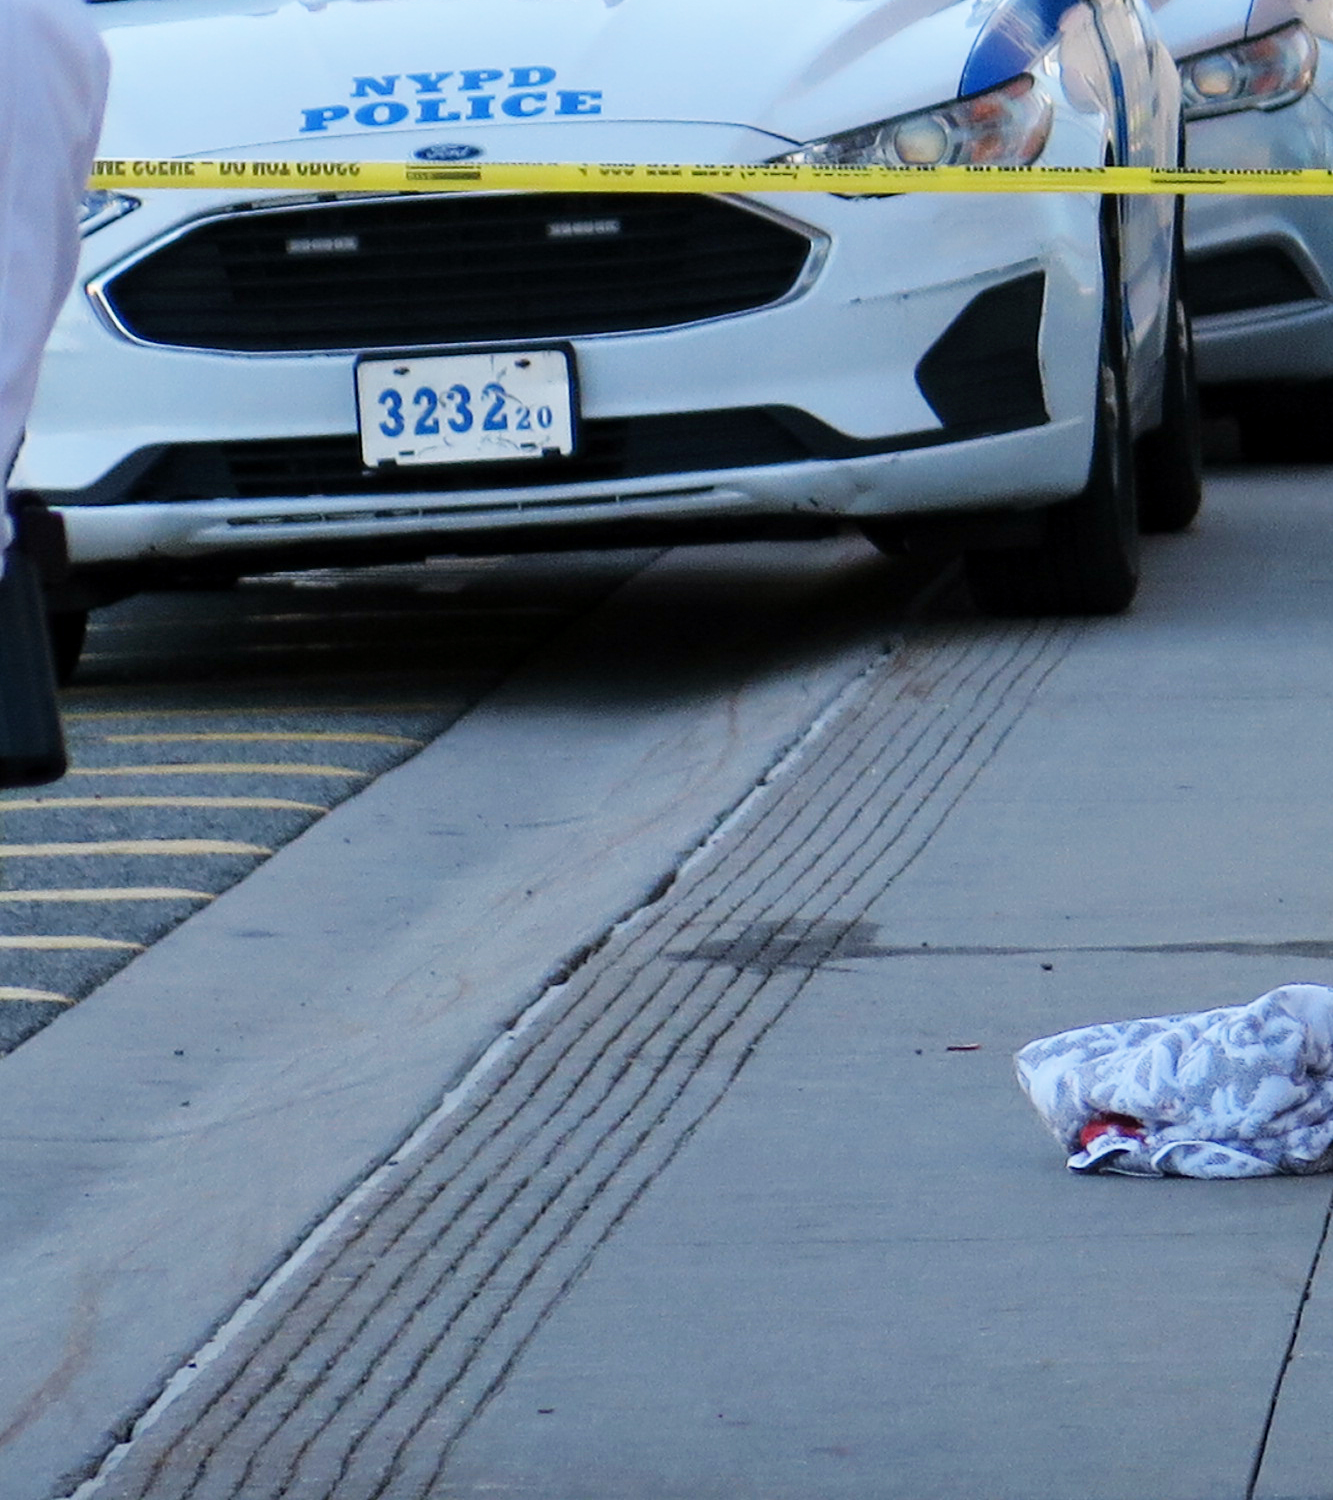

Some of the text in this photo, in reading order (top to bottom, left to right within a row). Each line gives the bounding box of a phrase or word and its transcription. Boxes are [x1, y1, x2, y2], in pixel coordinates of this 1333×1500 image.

[350, 65, 557, 98] NYPD
[299, 90, 603, 132] POLICE
[377, 382, 553, 438] 3232 20
